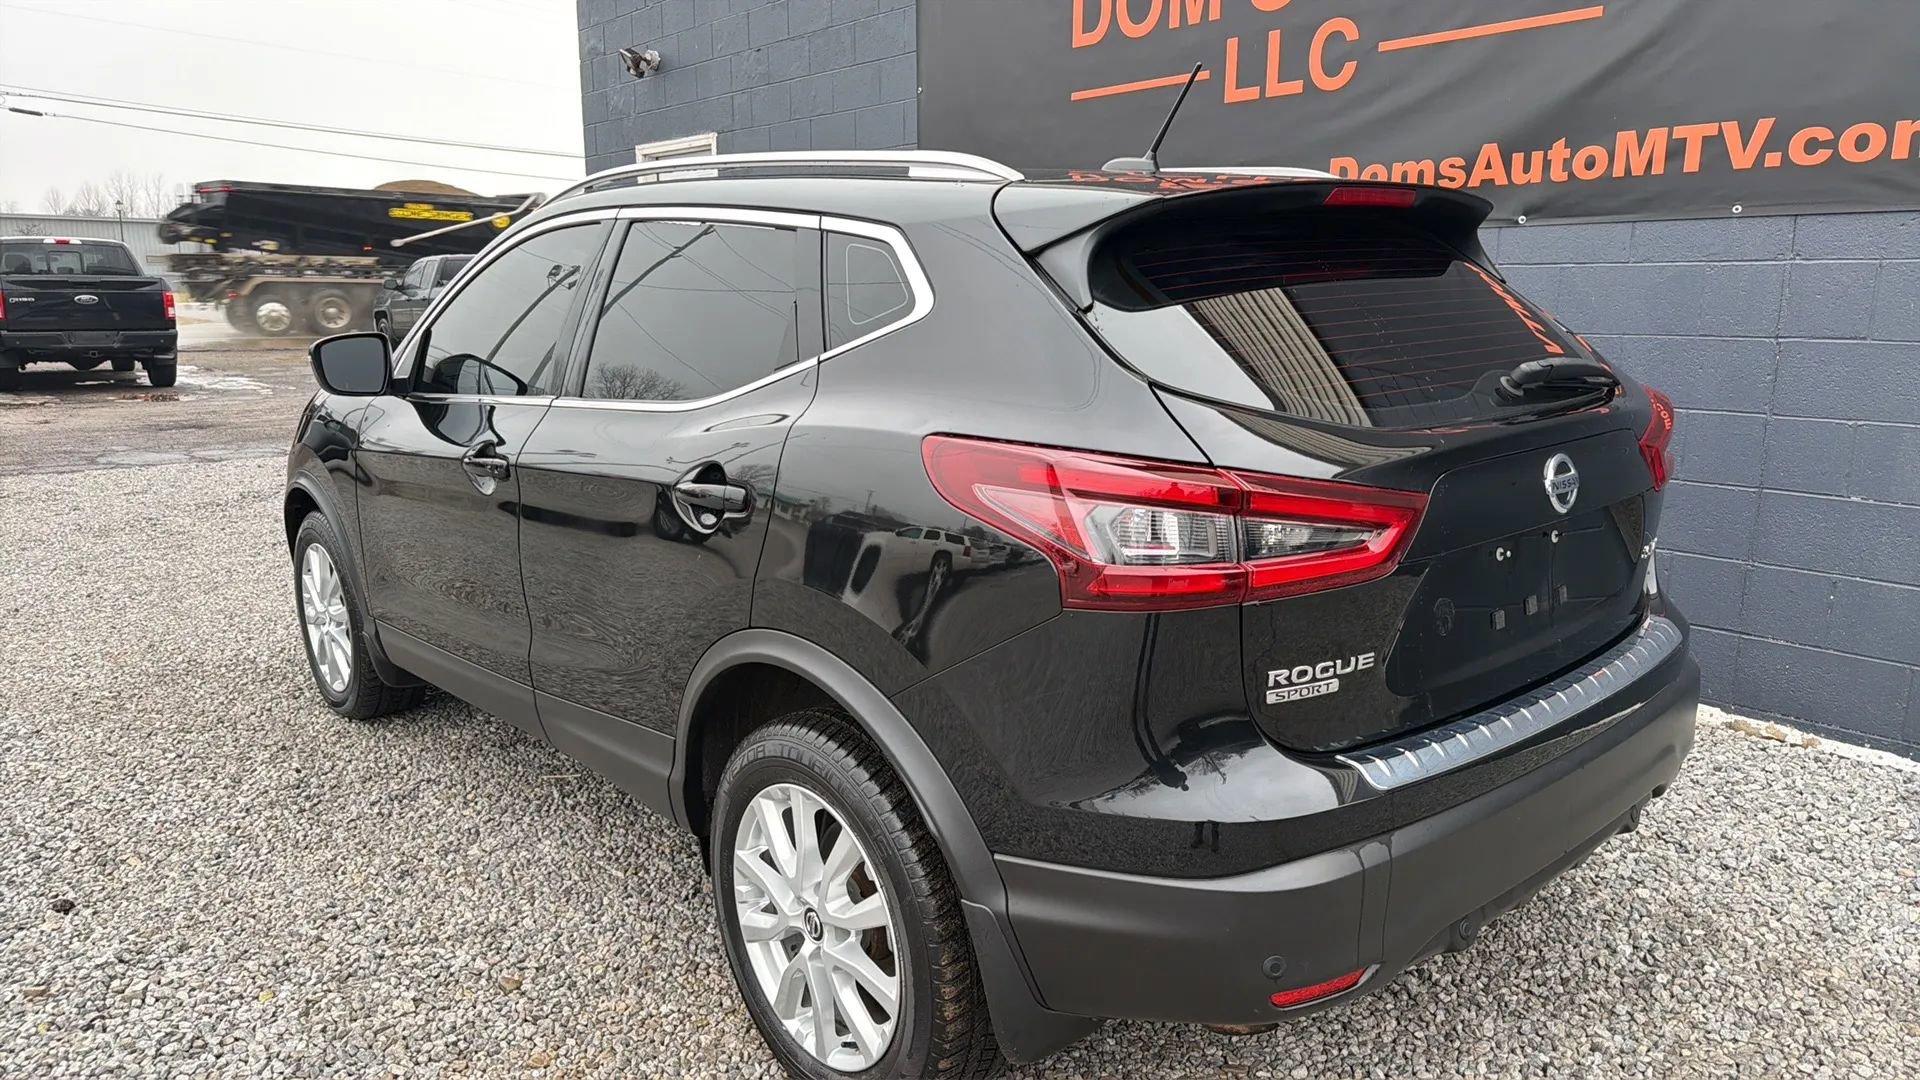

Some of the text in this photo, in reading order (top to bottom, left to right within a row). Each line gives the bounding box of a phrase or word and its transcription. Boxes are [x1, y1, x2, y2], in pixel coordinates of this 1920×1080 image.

[1224, 17, 1359, 103] LLC
[1267, 651, 1376, 687] ROGUE
[1272, 680, 1335, 702] SPORT
